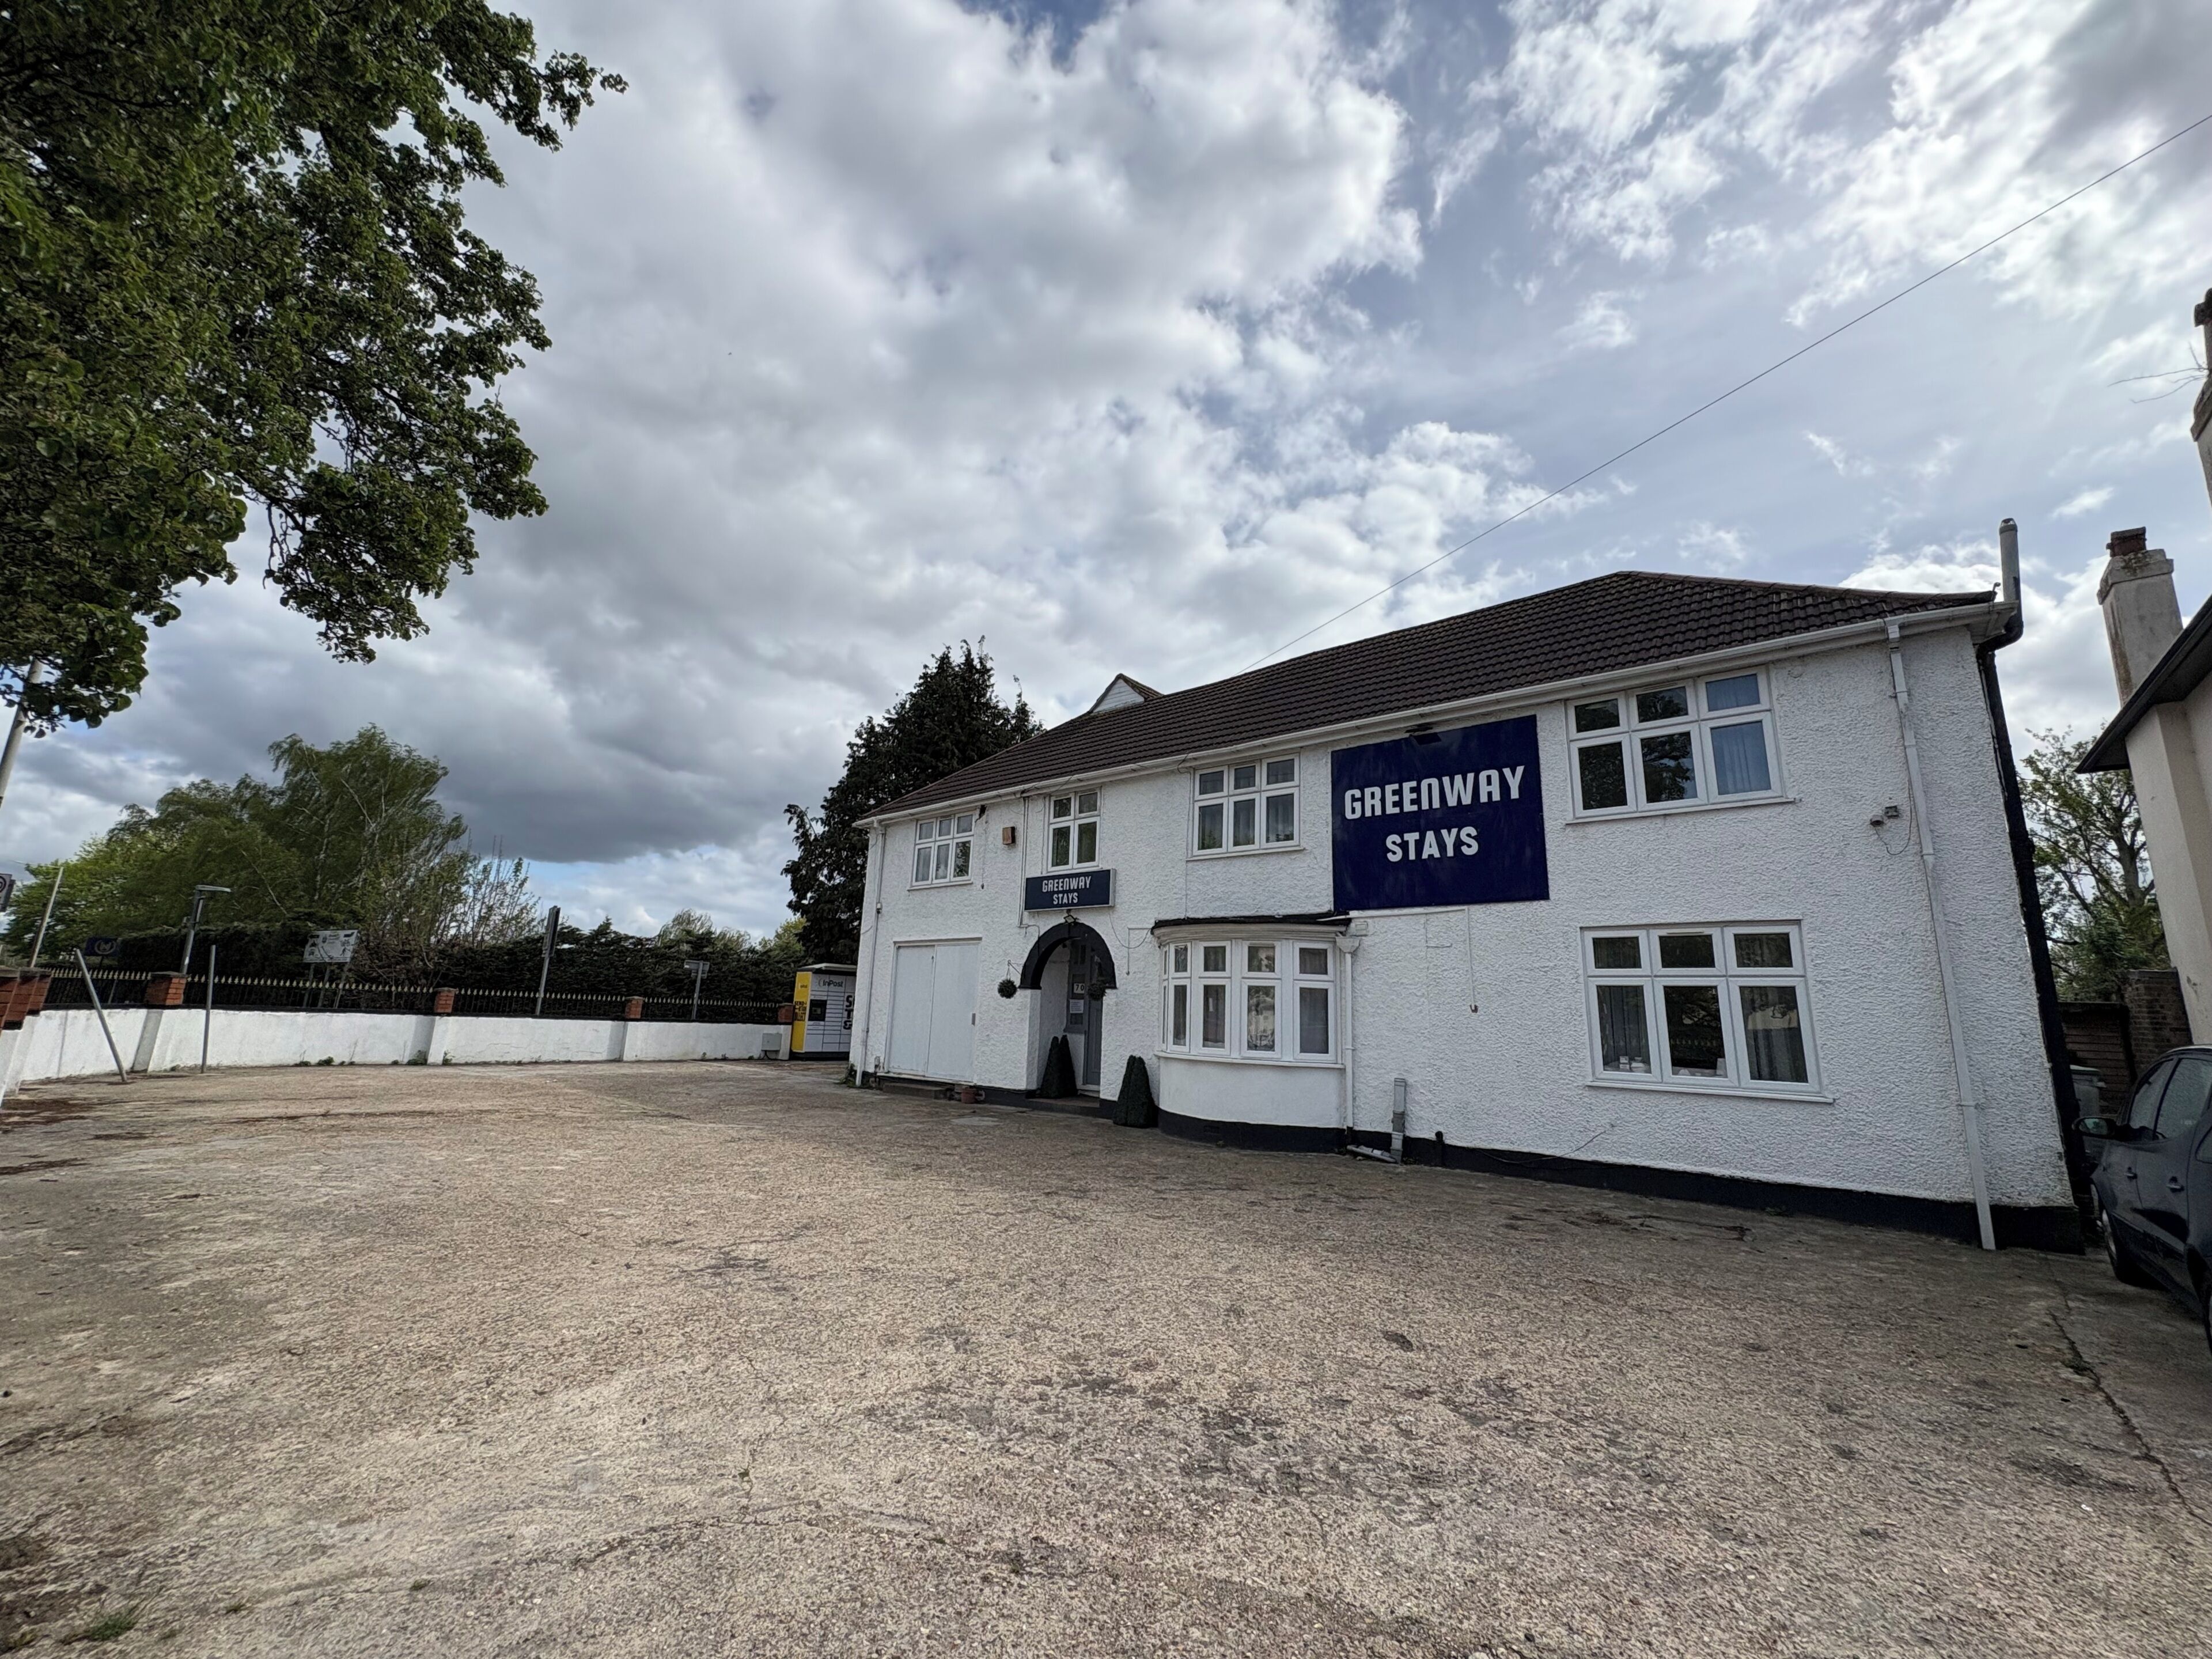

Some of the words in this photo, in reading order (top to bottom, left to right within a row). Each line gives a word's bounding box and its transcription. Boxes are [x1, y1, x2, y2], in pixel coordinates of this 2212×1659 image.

[1344, 765, 1525, 820] GREENWAY
[1386, 826, 1479, 862] STAYS
[1041, 876, 1092, 892] GREENWAY
[1053, 892, 1078, 905] STAYS
[822, 979, 844, 988] InPost
